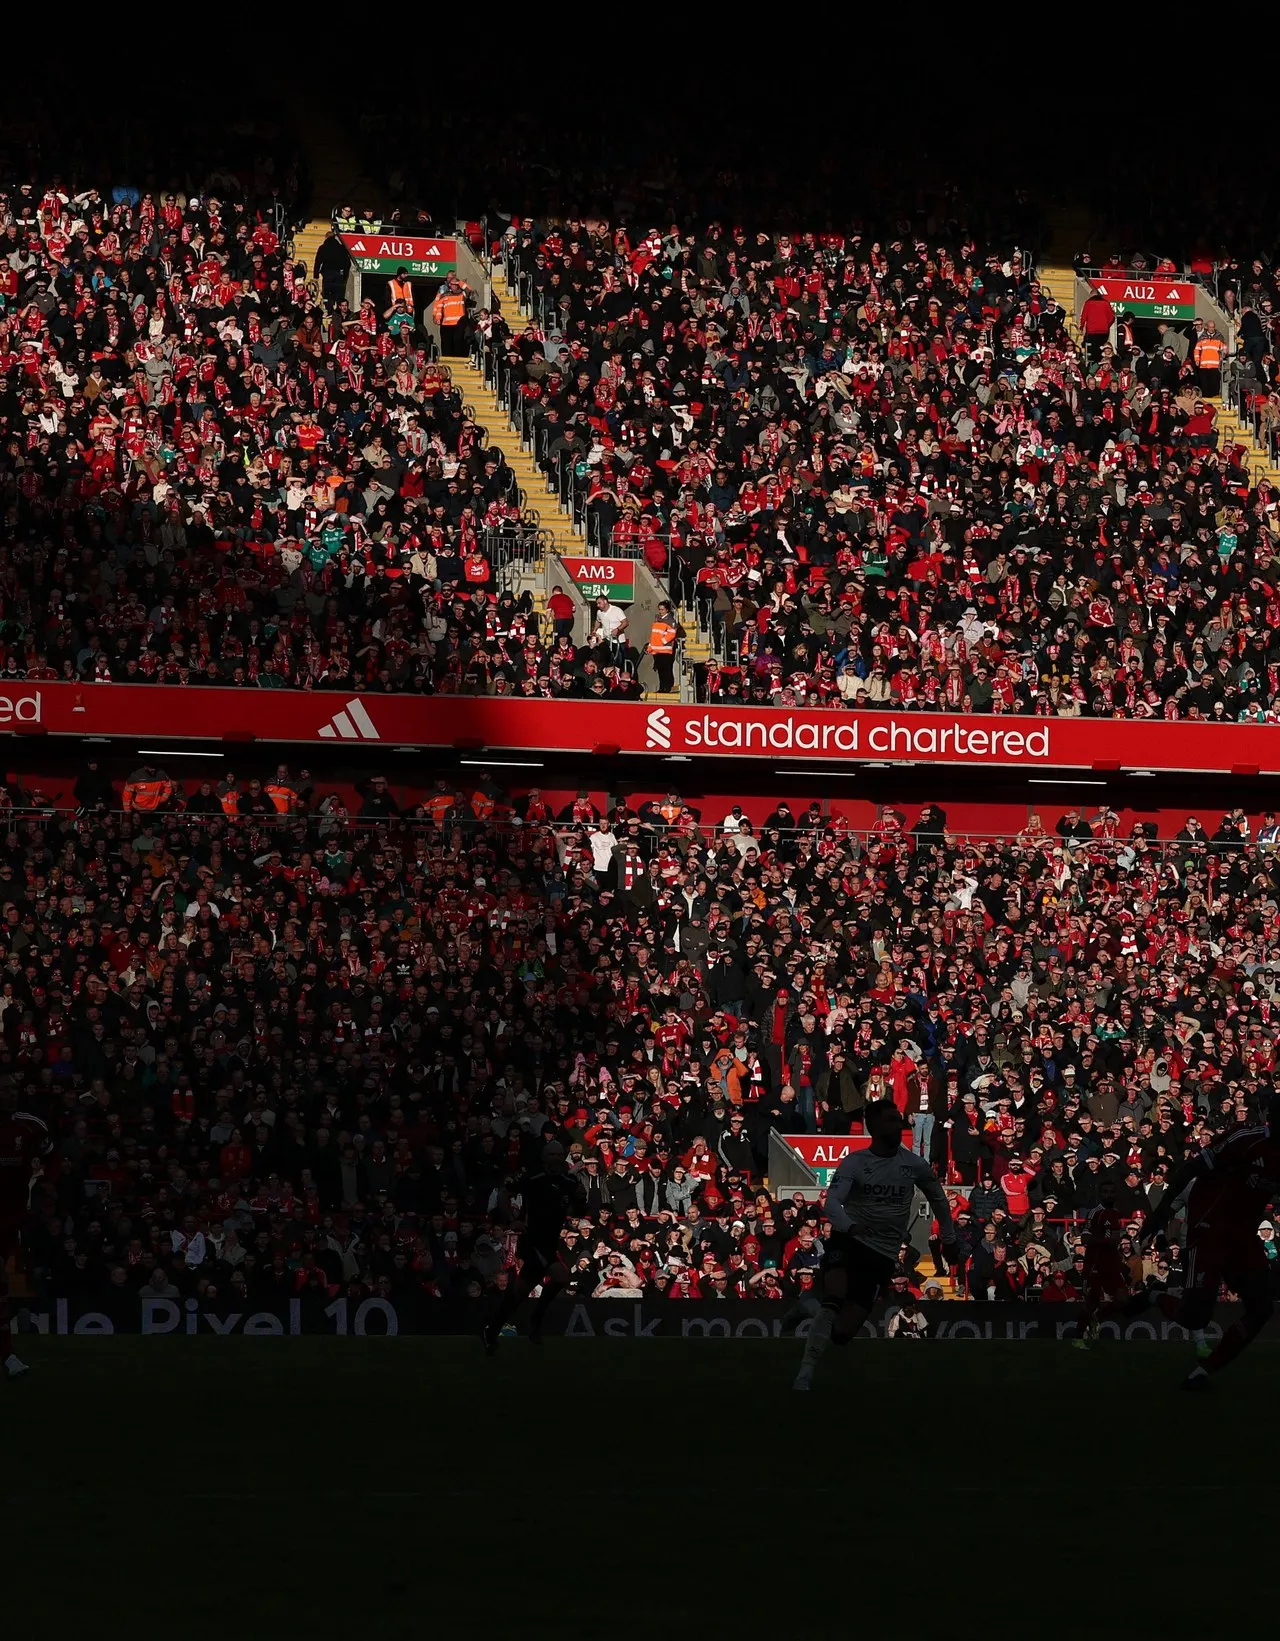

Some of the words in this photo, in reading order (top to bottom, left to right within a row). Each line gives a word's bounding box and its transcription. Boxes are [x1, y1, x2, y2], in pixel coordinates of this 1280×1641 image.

[378, 242, 414, 257] AU3
[1123, 286, 1156, 300] AU2
[577, 565, 615, 579] AM3
[0, 691, 41, 722] ed
[684, 714, 859, 750] standard
[868, 721, 1049, 757] chartered
[863, 1183, 906, 1197] BOYLE
[141, 1297, 301, 1335] Pixel
[323, 1297, 400, 1335] 10
[564, 1303, 663, 1337] Ask
